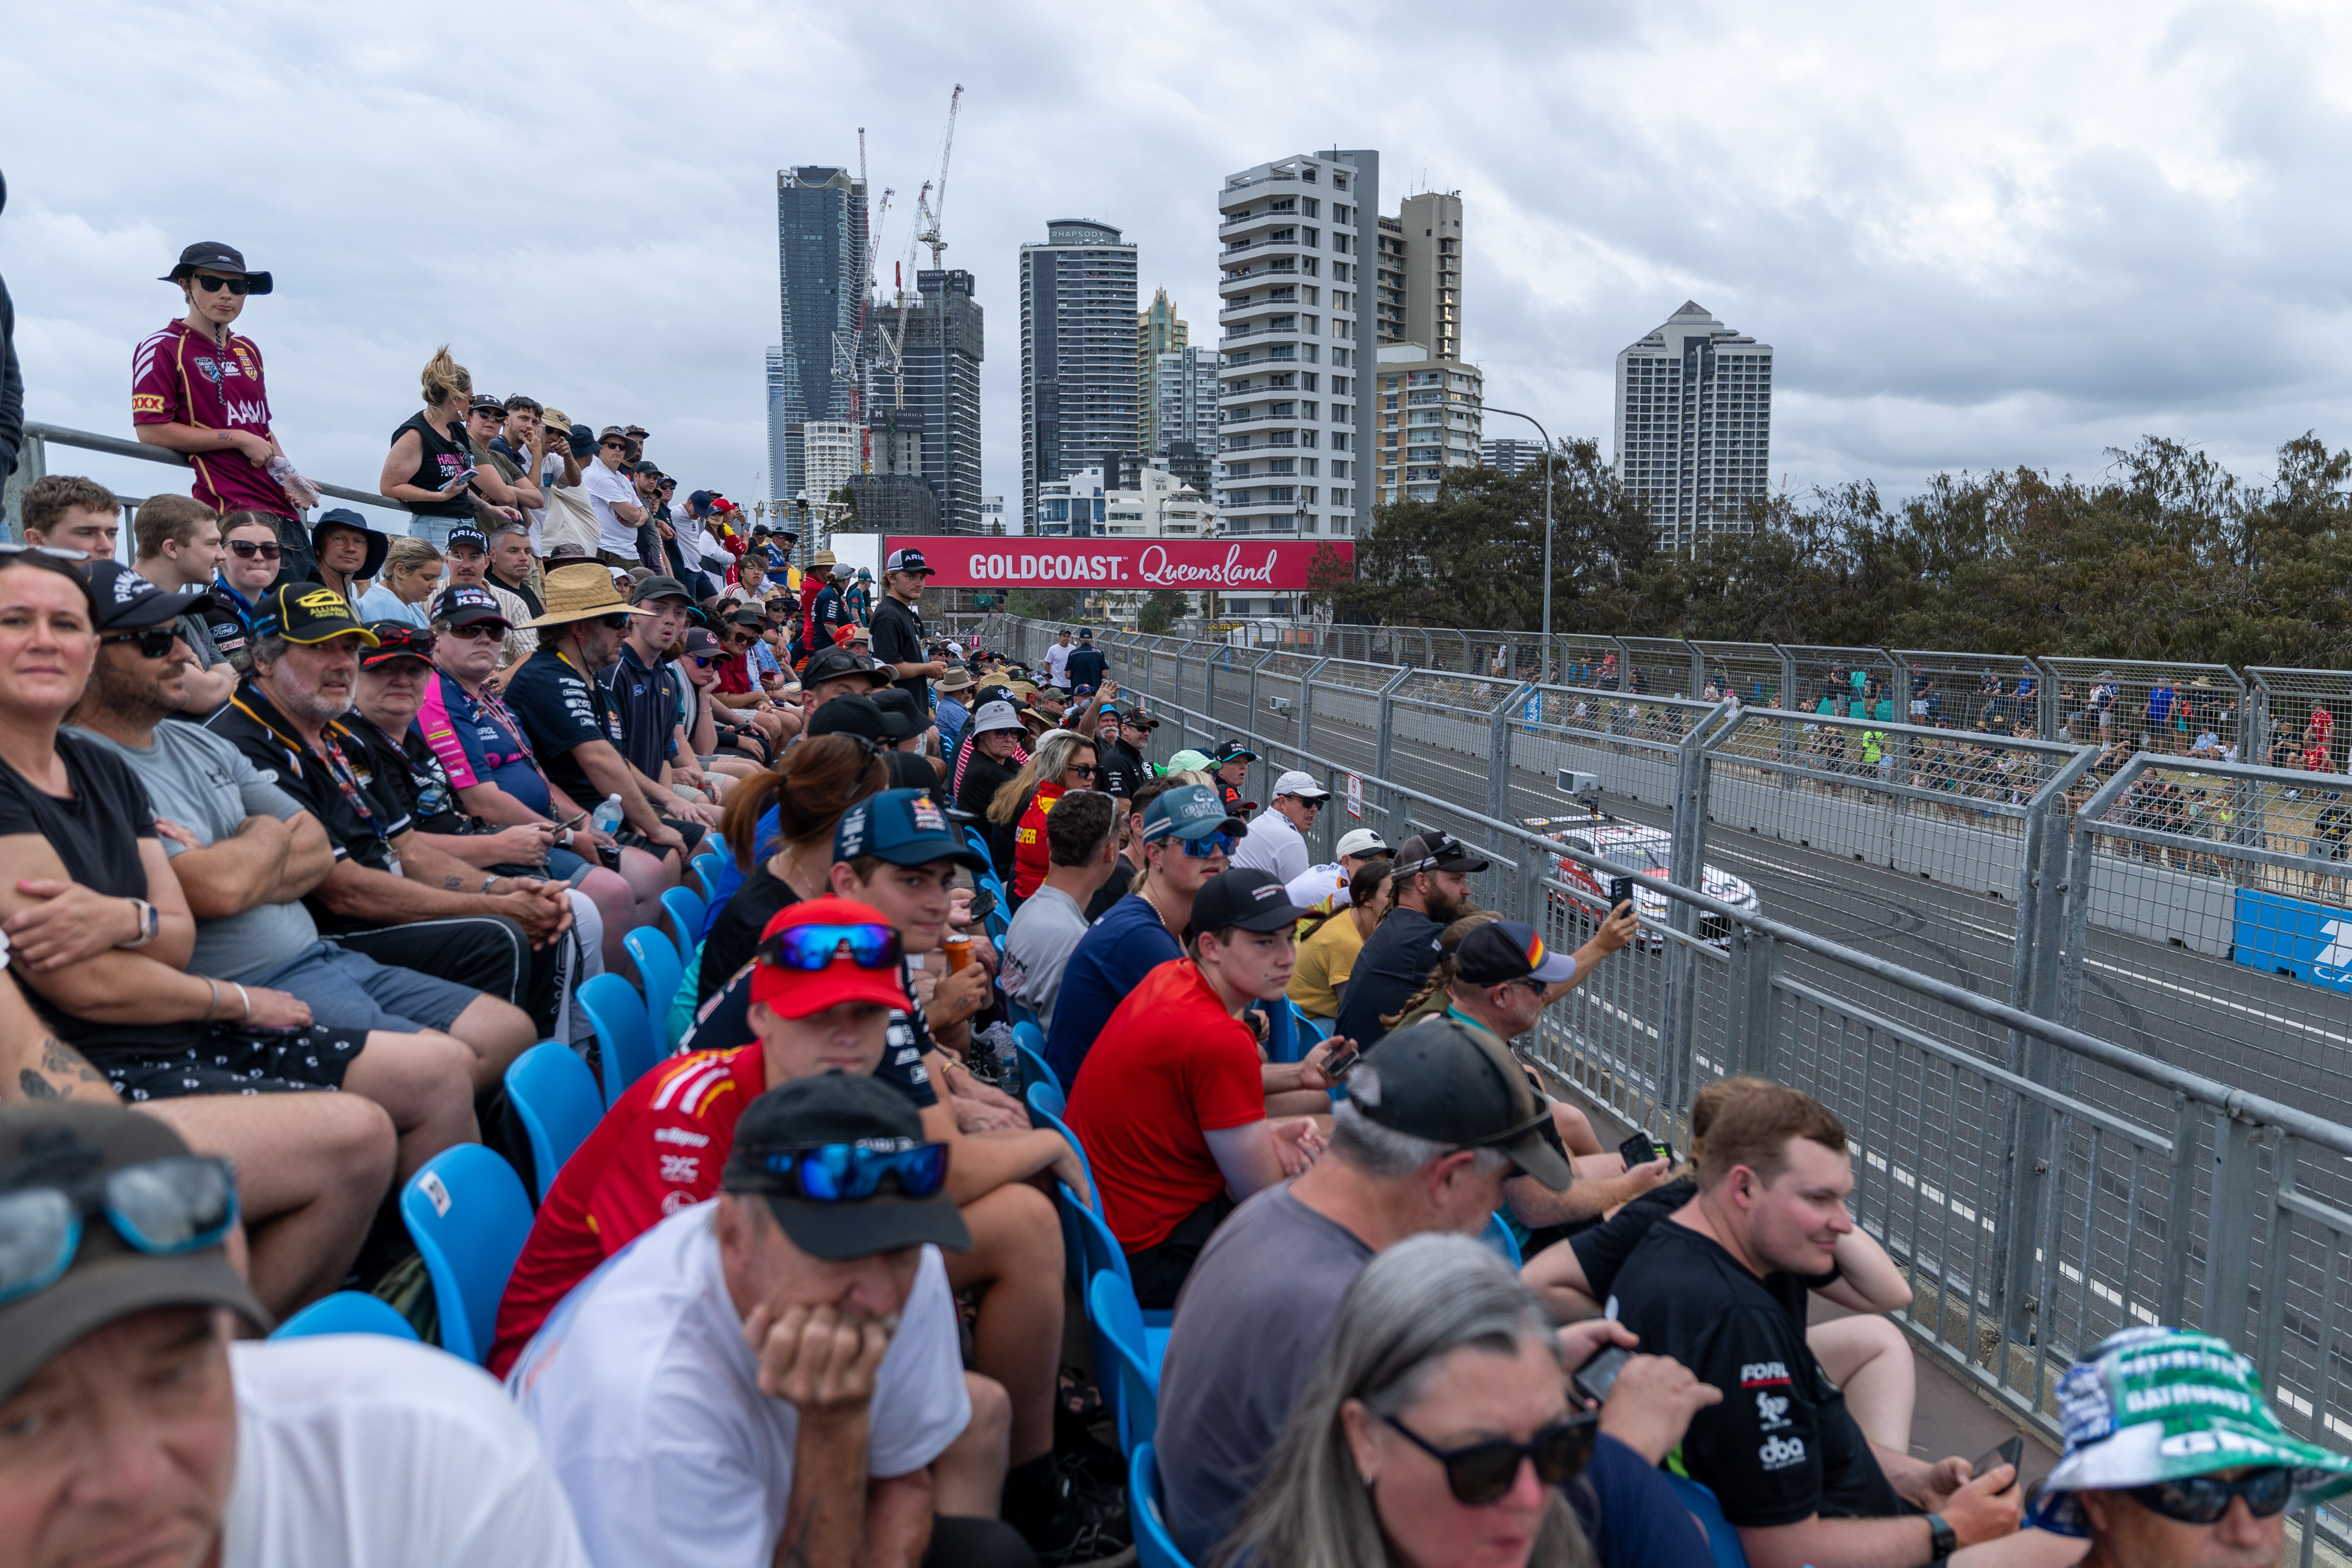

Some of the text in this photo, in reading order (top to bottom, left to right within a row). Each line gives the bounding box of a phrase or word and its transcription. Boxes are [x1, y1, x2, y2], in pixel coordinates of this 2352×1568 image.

[451, 530, 484, 540] ARIAT
[969, 554, 1129, 580] GOLDCOAST.
[1139, 544, 1278, 586] Queensland
[213, 625, 233, 636] Ford
[221, 638, 243, 651] Castrol
[1351, 795, 1360, 805] SMOKING
[1759, 1434, 1804, 1465] dba
